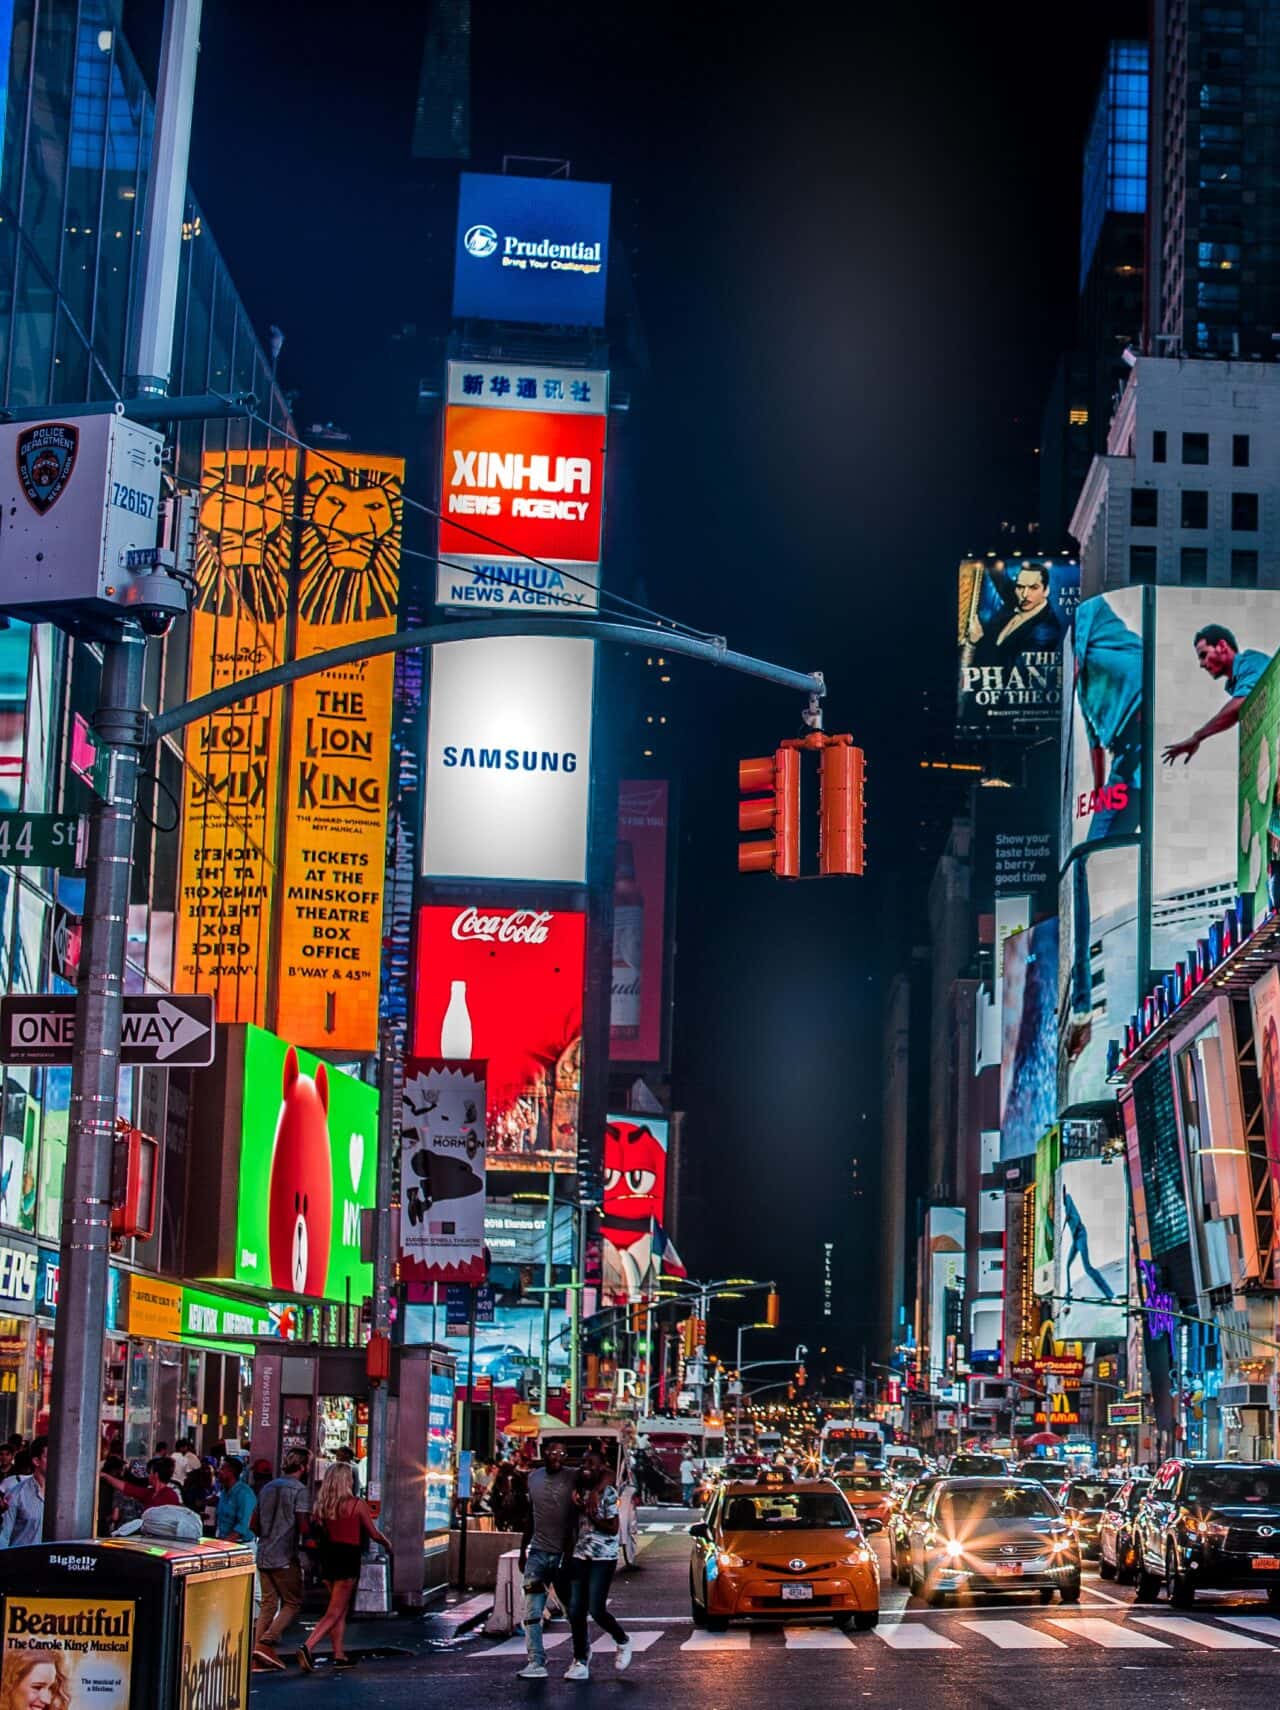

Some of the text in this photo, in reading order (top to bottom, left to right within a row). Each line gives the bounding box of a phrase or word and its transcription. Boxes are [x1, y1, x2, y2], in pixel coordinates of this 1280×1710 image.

[503, 236, 601, 261] Prudential
[463, 373, 591, 403] 新华通讯社
[33, 427, 65, 439] POLICE
[20, 437, 75, 456] DEPARTMENT
[451, 450, 592, 494] XINHUA
[449, 494, 589, 521] NEWS AGENCY
[471, 564, 565, 590] XINHUA
[451, 585, 585, 607] NEWS AGENCY
[1022, 652, 1061, 665] THE
[315, 690, 364, 715] THE
[975, 690, 1001, 705] OF
[1004, 691, 1042, 705] THE
[306, 718, 373, 757] LION
[443, 746, 577, 774] SAMSUNG
[298, 761, 380, 809] KING
[1076, 783, 1129, 819] JEANS
[52, 821, 76, 847] St
[995, 834, 1050, 846] Show your
[302, 850, 369, 867] TICKETS
[995, 846, 1051, 858] taste buds
[1004, 860, 1036, 871] berry
[305, 870, 364, 885] AT THE
[994, 872, 1047, 885] good time
[288, 886, 379, 905] MINSKOFF
[296, 906, 369, 924] THEATRE
[313, 926, 351, 941] BOX
[452, 906, 554, 944] Coca-Cola
[302, 945, 360, 960] OFFICE
[288, 966, 328, 978] B'WAY
[332, 968, 341, 979] &
[18, 1016, 184, 1043] ONE WAY
[49, 1555, 97, 1567] BigBelly
[8, 1605, 132, 1637] Beautiful
[8, 1637, 129, 1653] The Carole King Musical
